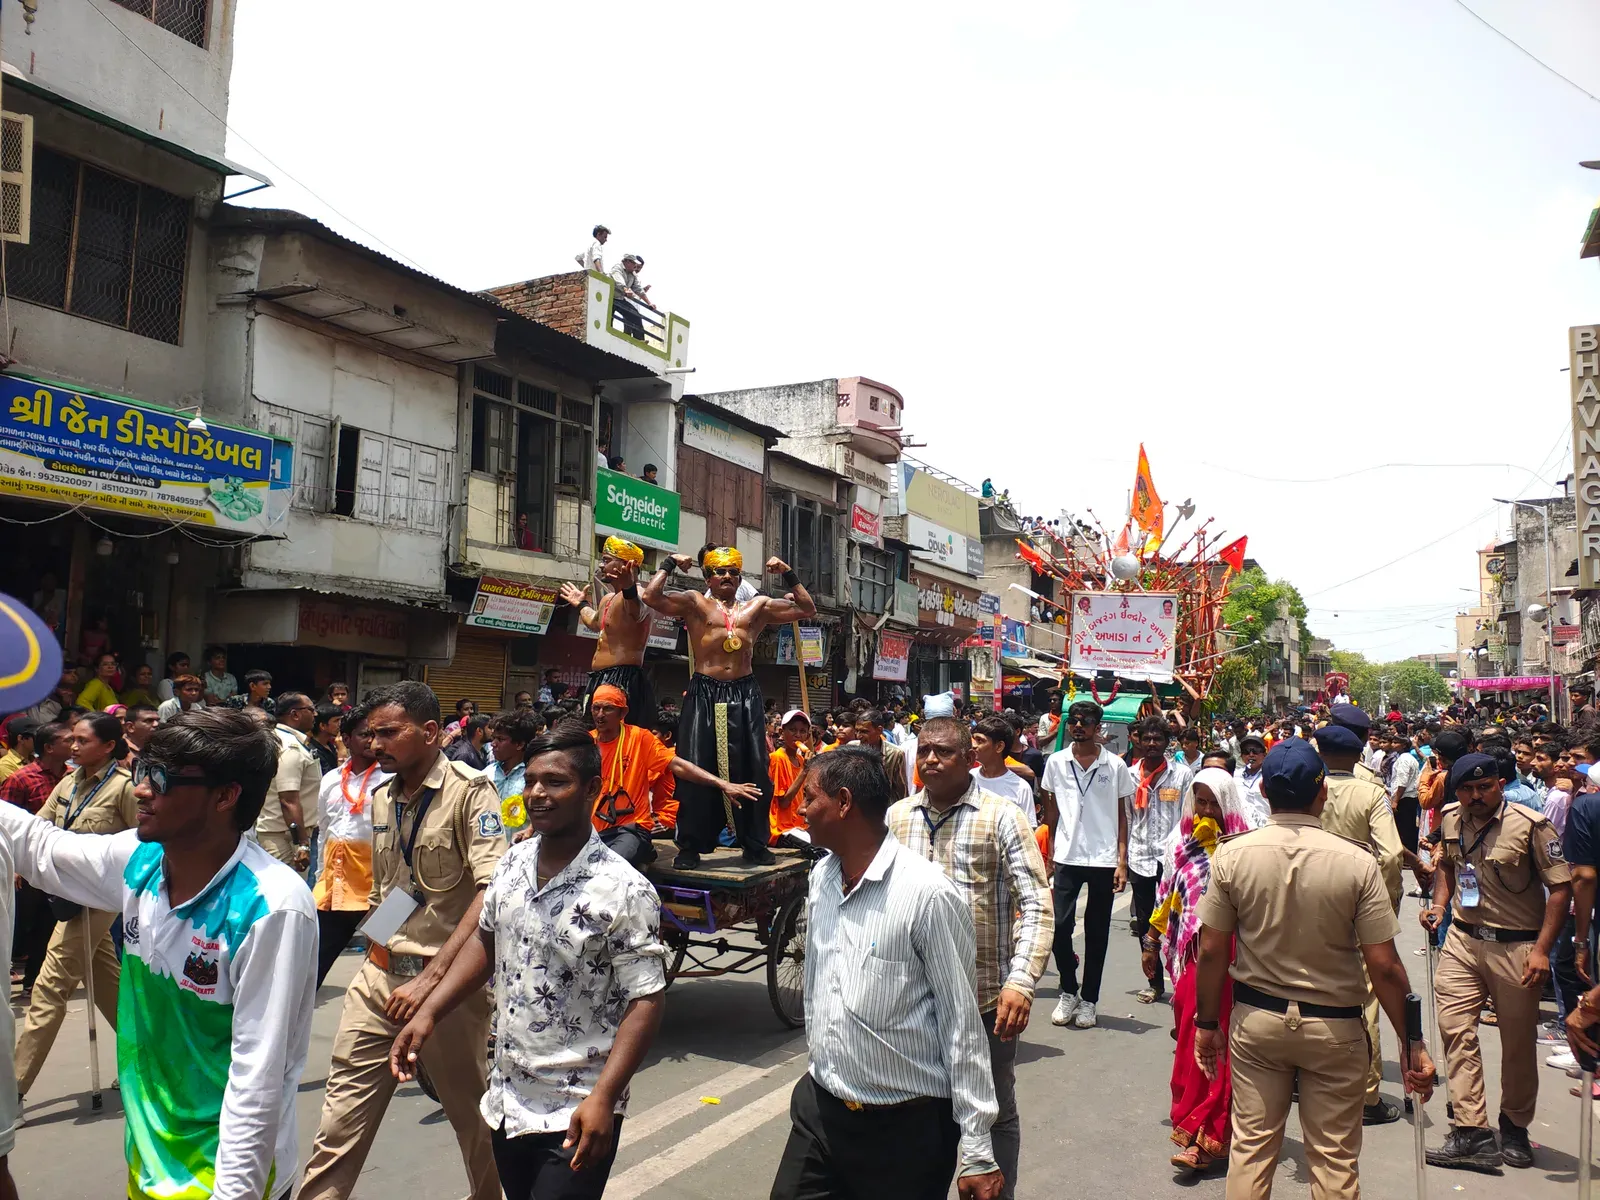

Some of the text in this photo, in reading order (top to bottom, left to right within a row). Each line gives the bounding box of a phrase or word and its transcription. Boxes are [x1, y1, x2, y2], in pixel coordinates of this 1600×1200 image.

[9, 389, 52, 428] શ્રી
[60, 394, 109, 439] જૈન
[38, 472, 93, 488] 9925220097
[157, 493, 204, 507] 7878495935
[607, 484, 668, 519] Schneider
[632, 510, 666, 531] Electric
[1095, 632, 1128, 643] અખાડા
